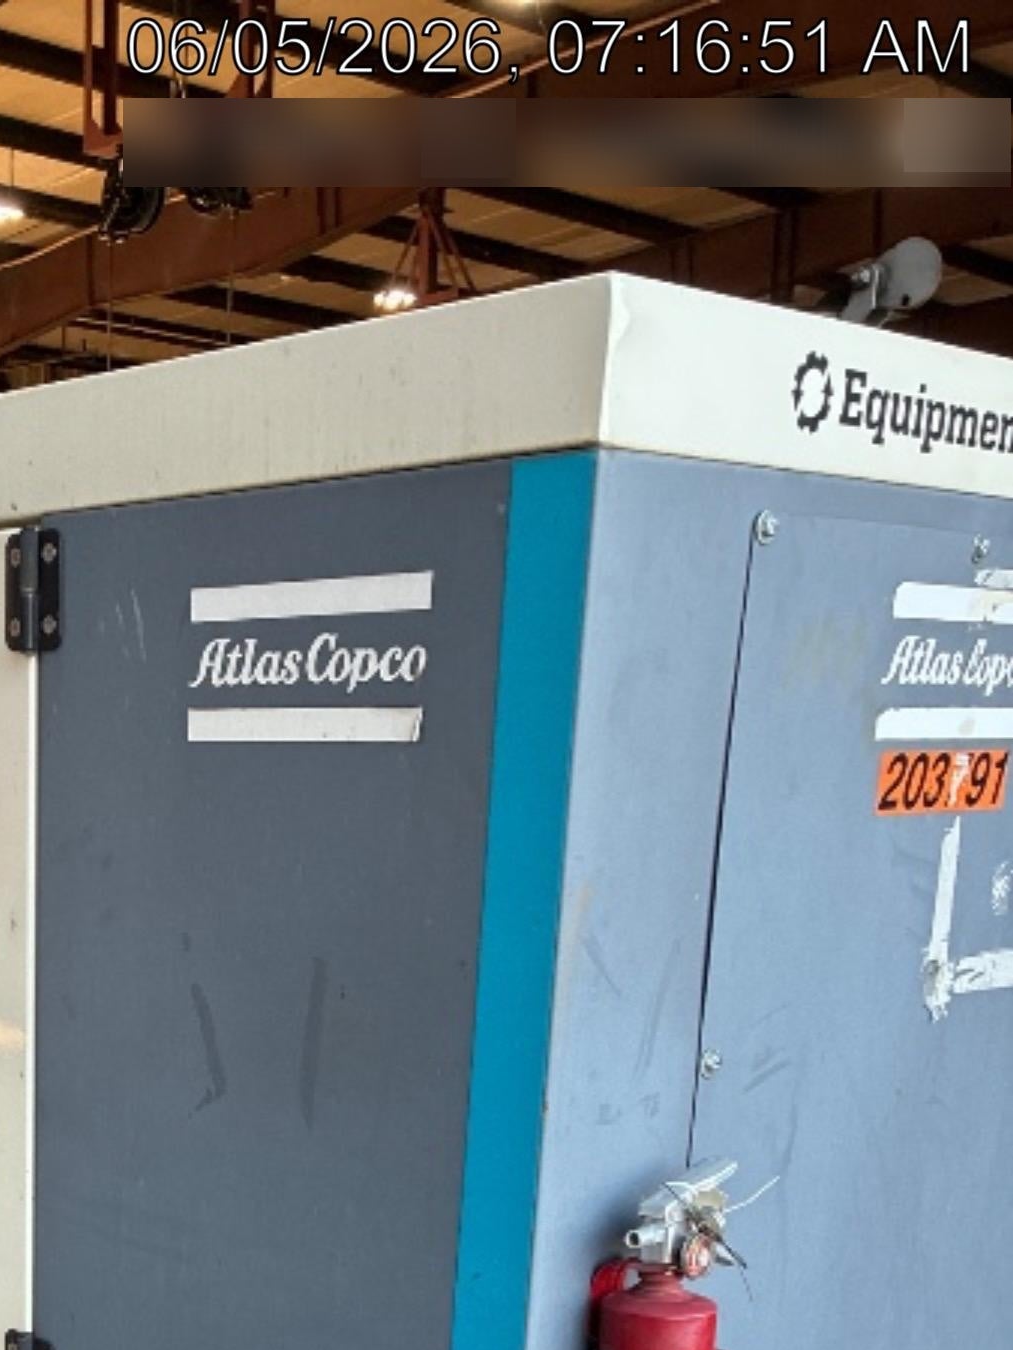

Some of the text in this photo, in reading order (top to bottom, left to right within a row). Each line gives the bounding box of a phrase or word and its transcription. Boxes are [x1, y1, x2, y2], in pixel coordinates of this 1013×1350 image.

[188, 632, 427, 694] Atlas Copco
[880, 635, 963, 685] Atlas
